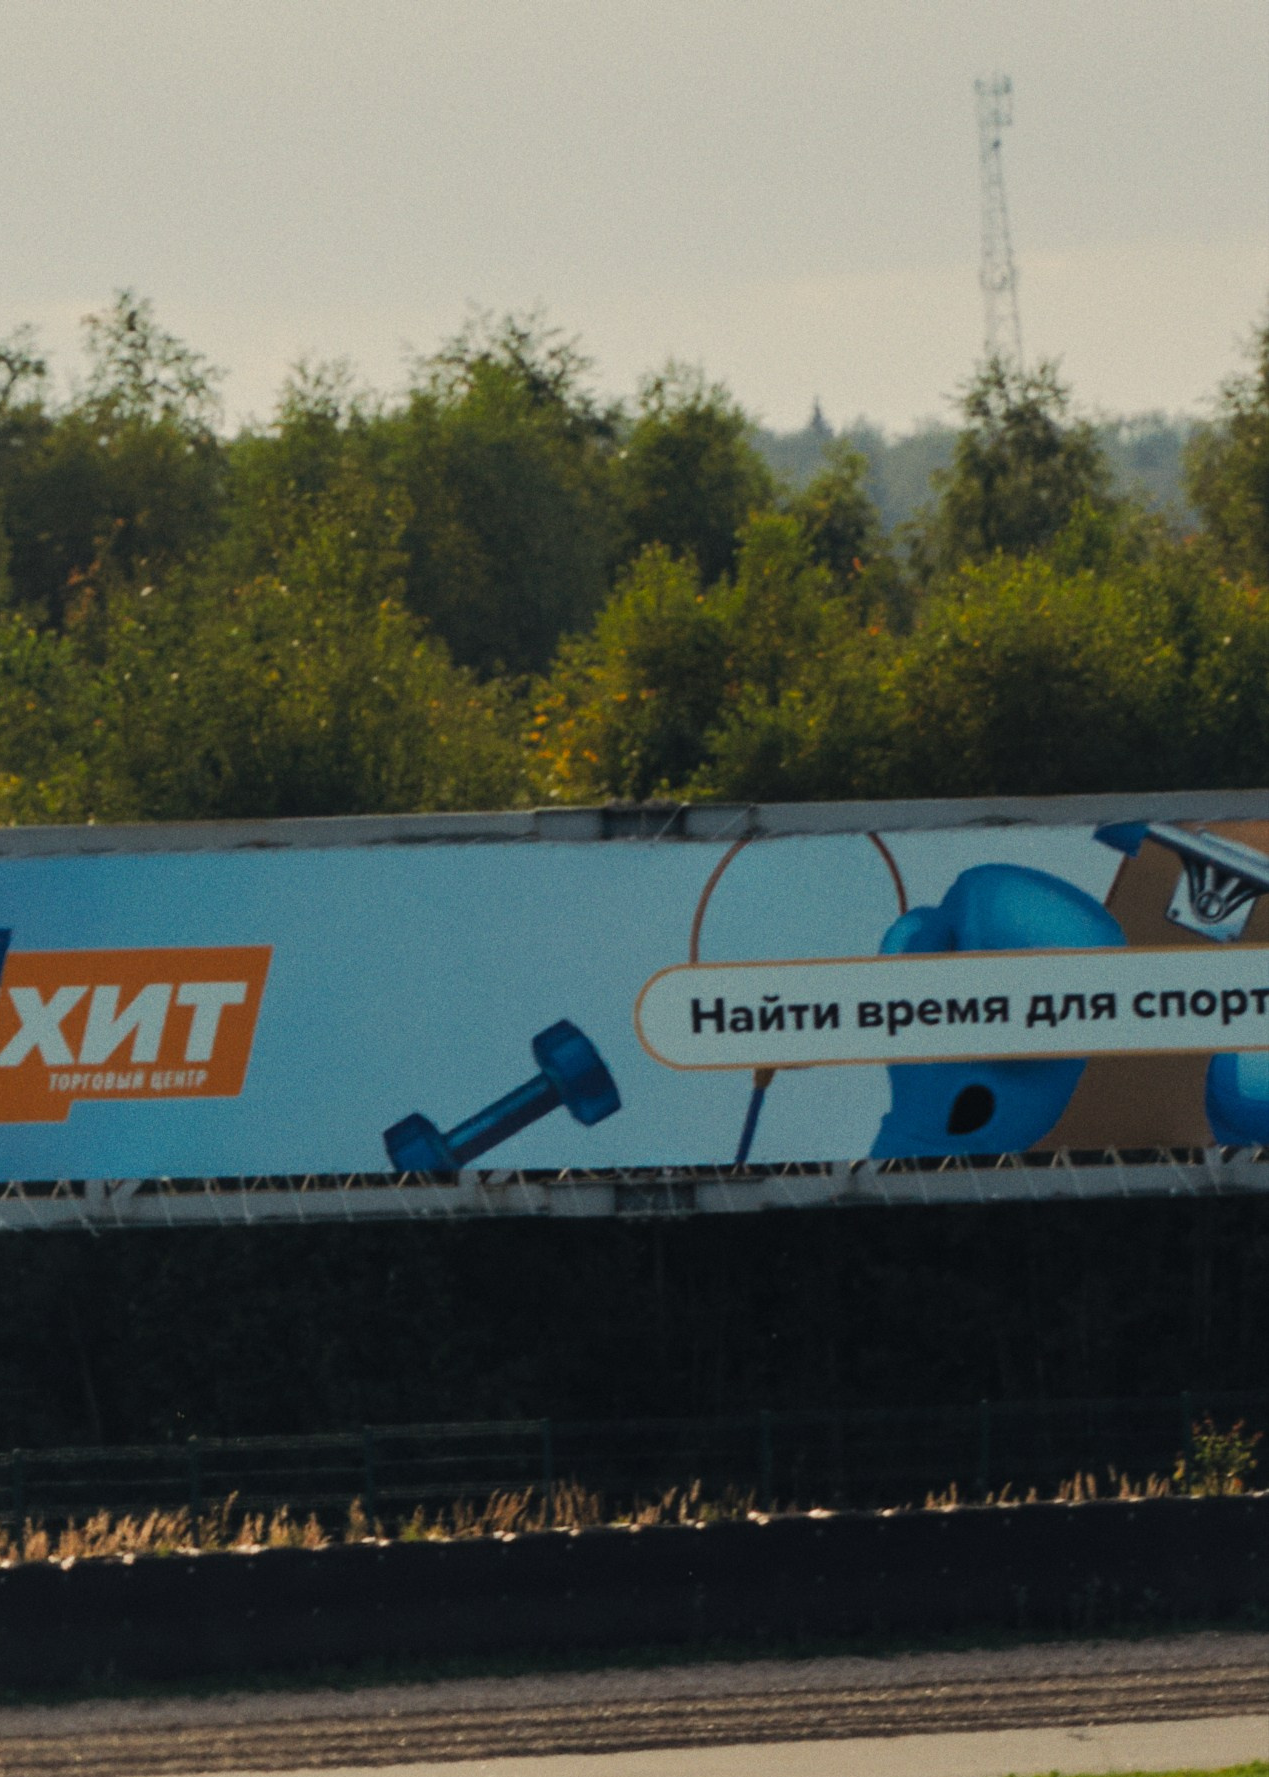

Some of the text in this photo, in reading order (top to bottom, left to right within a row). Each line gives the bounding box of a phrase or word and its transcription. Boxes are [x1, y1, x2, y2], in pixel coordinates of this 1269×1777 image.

[691, 994, 840, 1034] Найти
[857, 996, 1010, 1037] время
[1026, 992, 1117, 1029] для
[48, 1069, 208, 1092] ТОРГОВЫЙ ЦЕНТР
